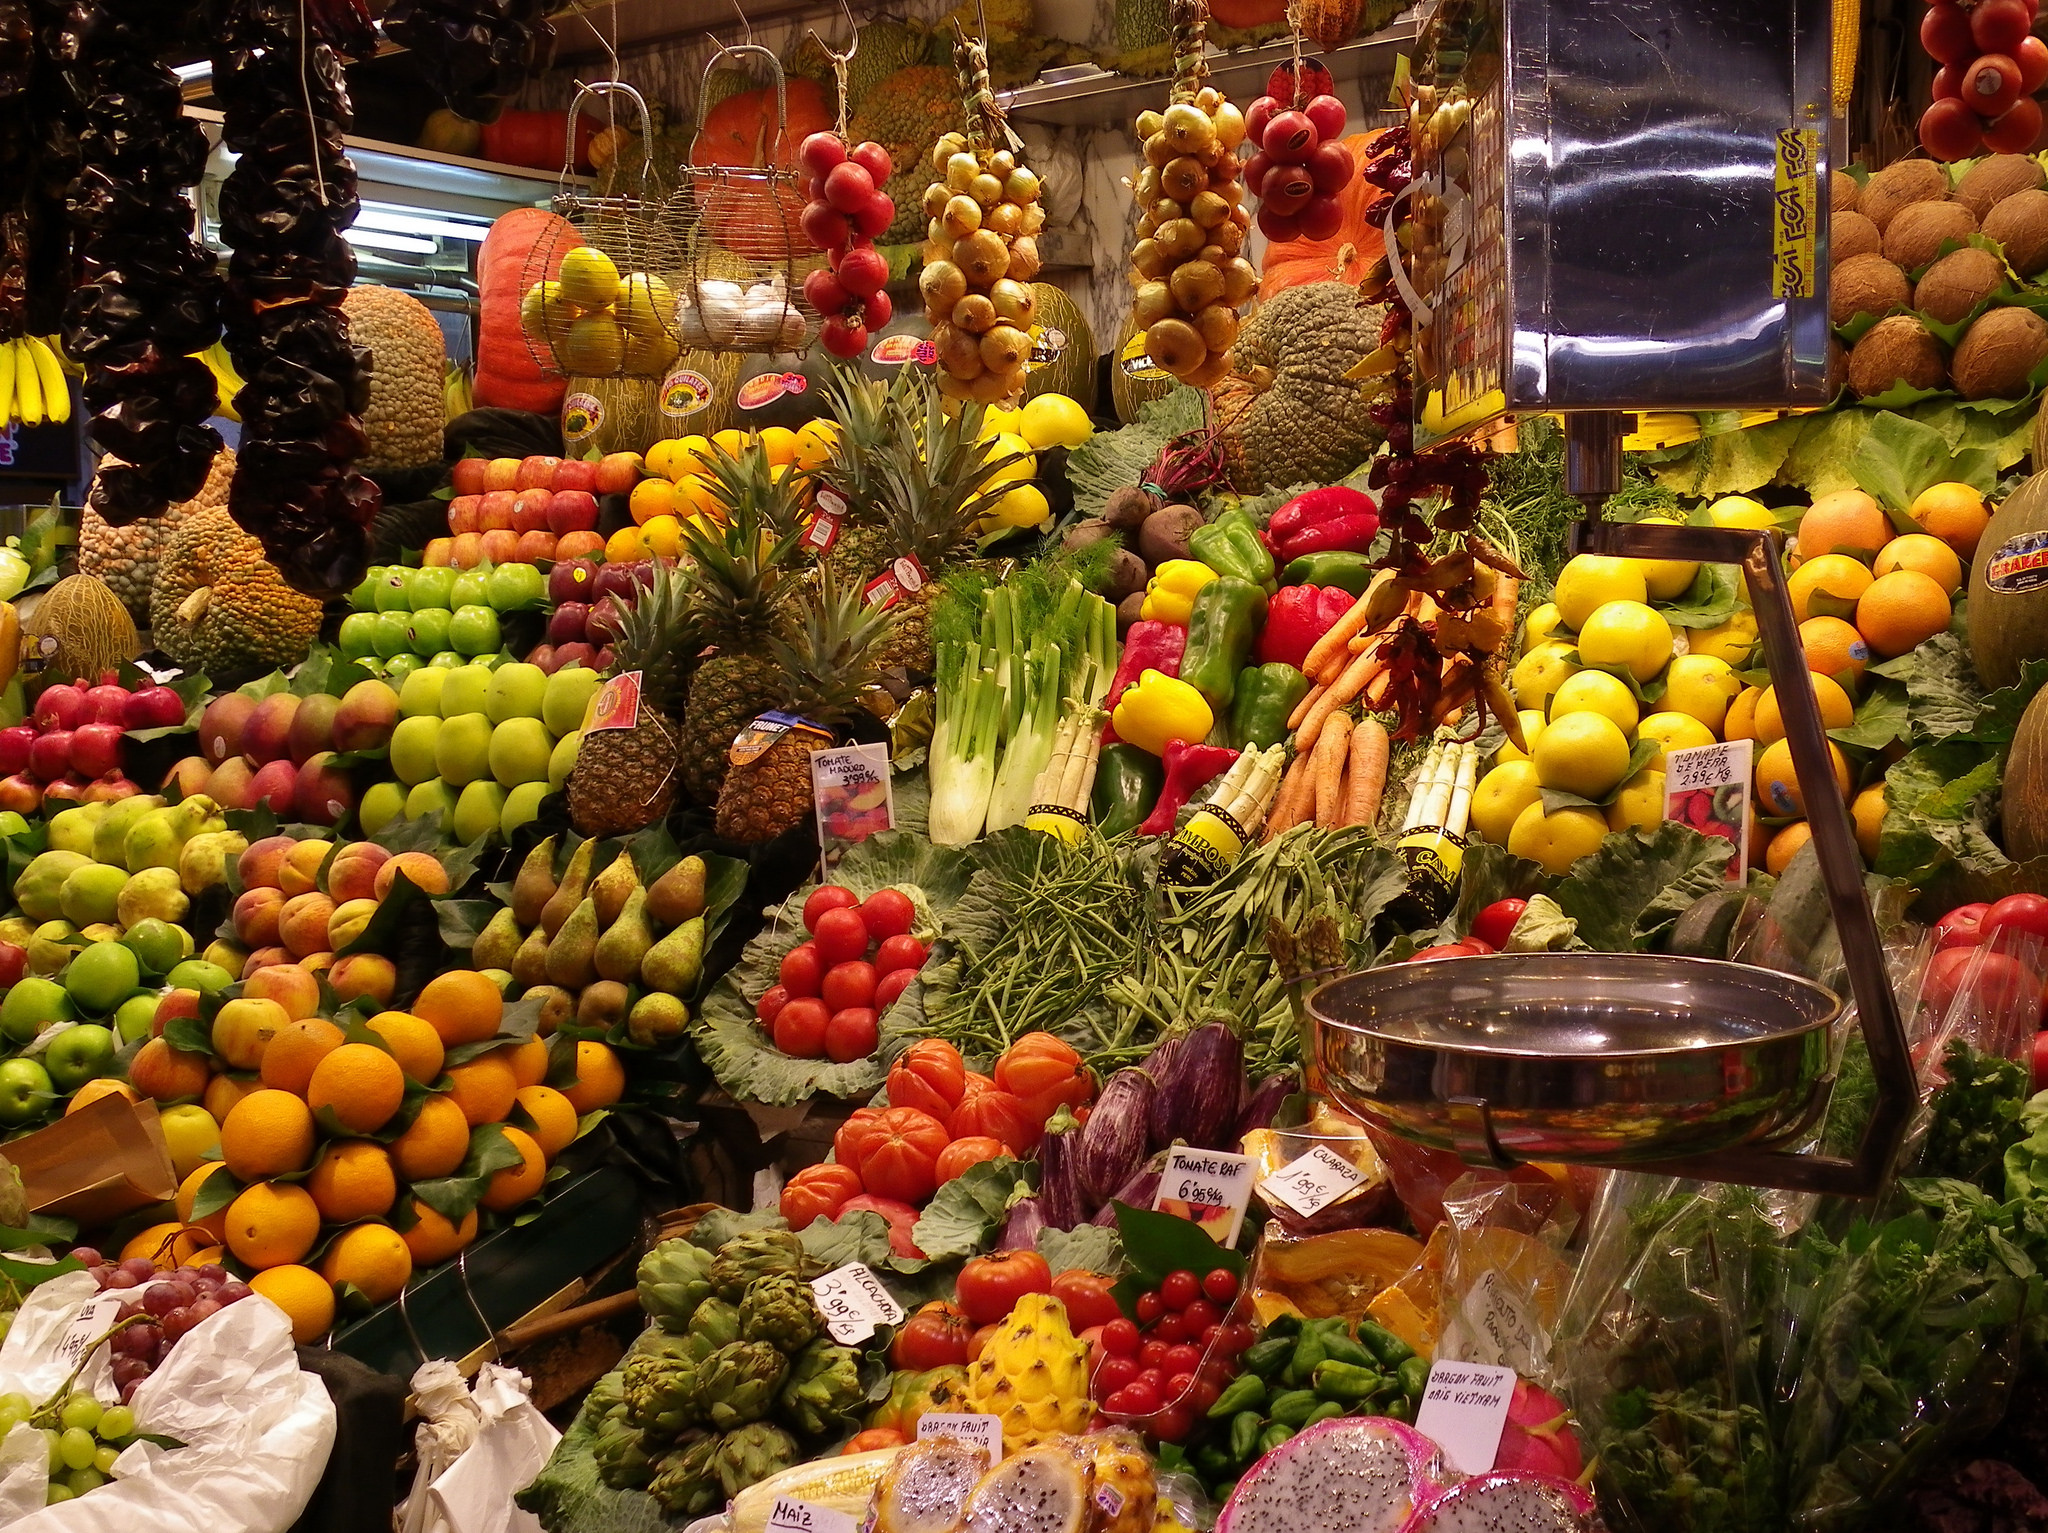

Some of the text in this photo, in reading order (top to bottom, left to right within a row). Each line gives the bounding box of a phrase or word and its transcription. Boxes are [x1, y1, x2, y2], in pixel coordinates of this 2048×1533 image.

[748, 720, 790, 734] FRUNET
[814, 755, 852, 769] TOMATE
[1674, 745, 1729, 764] TOMATE
[829, 763, 866, 775] MADURO
[1695, 756, 1728, 769] PERA
[1218, 1161, 1247, 1177] RAF
[1470, 1370, 1504, 1387] FRUIT
[1453, 1390, 1502, 1408] VIETNAM
[960, 1418, 990, 1433] FRUIT
